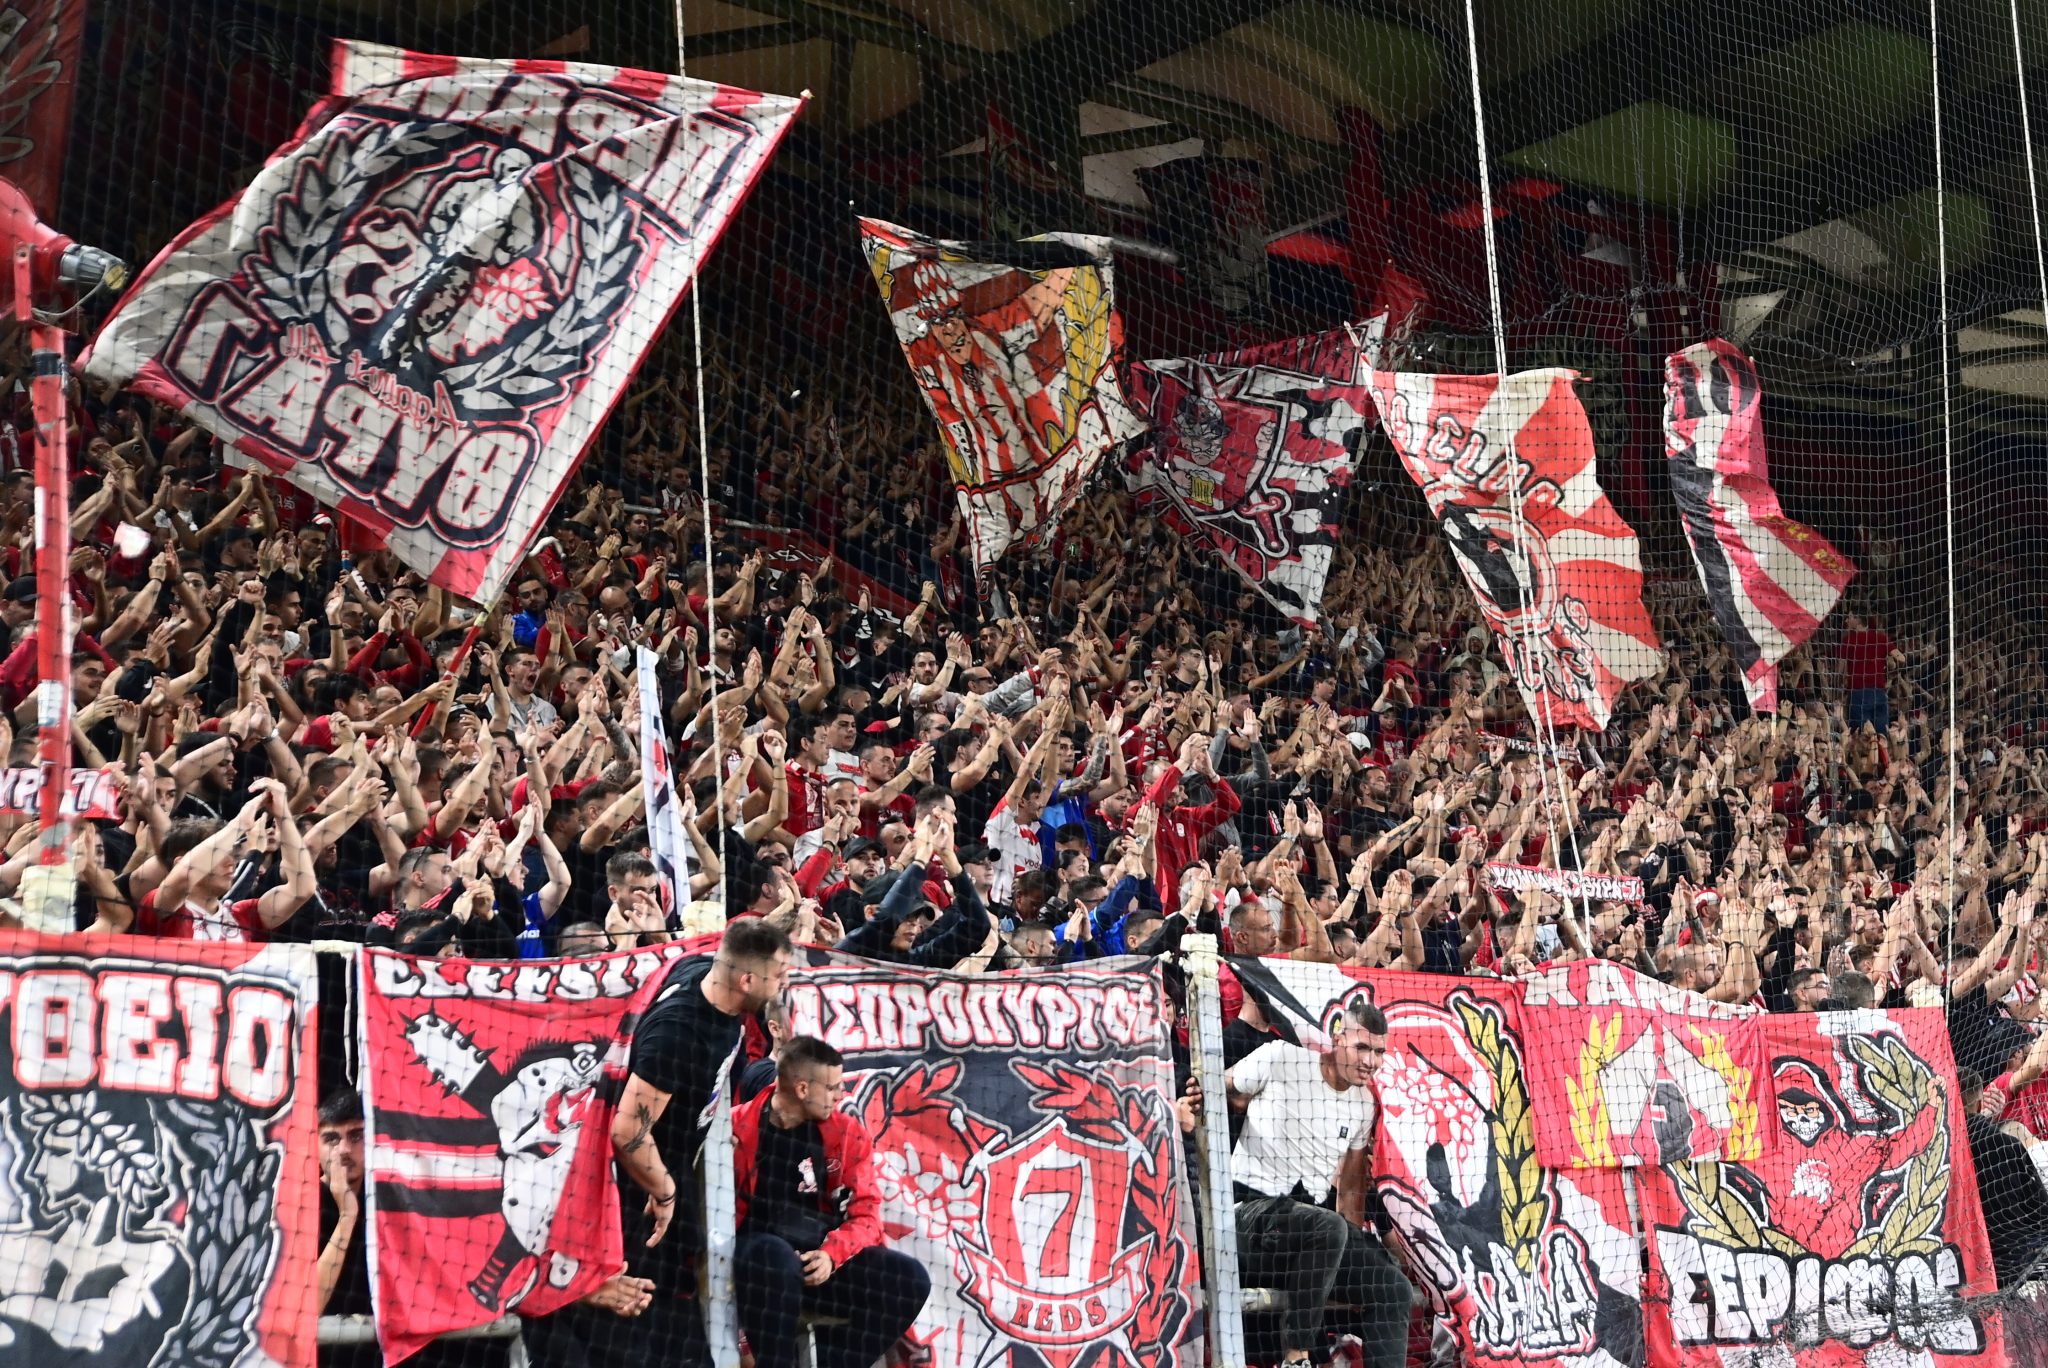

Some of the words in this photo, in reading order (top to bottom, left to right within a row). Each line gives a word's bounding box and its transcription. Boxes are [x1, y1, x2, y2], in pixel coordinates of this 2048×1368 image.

[0, 970, 294, 1107] ΘΕΙΟ
[1020, 1161, 1084, 1277] 7
[1010, 1295, 1107, 1332] REDS
